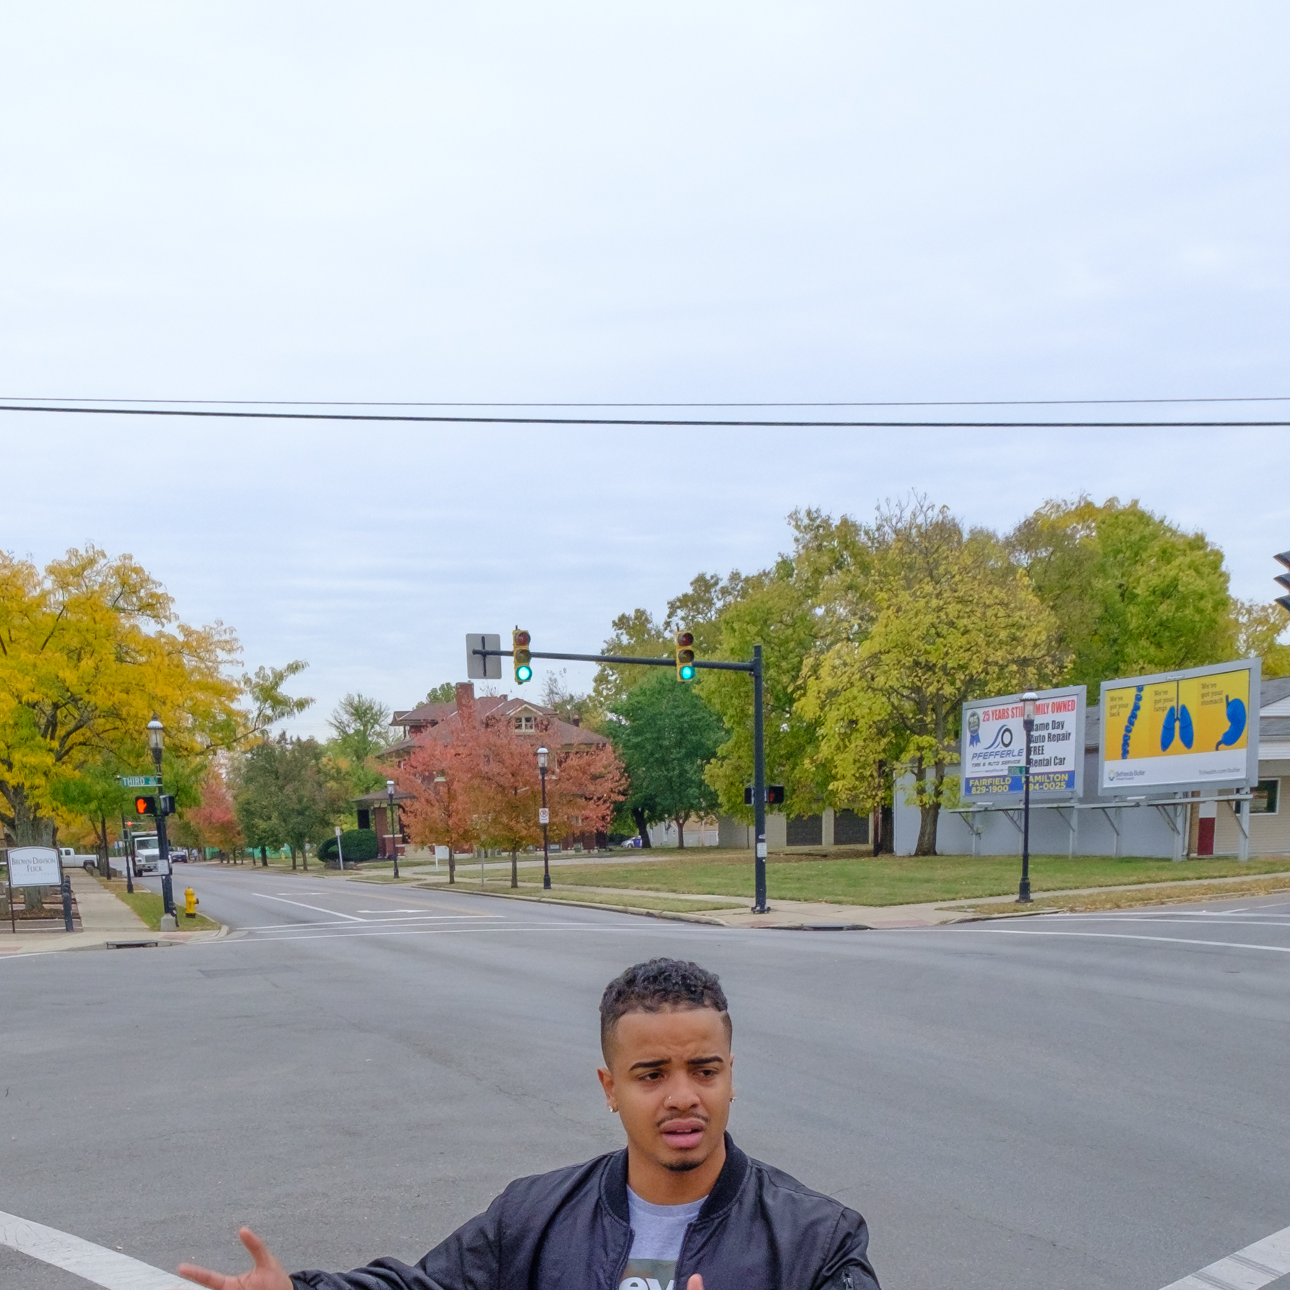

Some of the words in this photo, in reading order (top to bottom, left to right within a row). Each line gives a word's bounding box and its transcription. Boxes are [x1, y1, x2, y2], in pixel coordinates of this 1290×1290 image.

[982, 709, 990, 722] 25
[991, 707, 1010, 720] YEARS
[1051, 699, 1076, 714] OWNED
[1033, 722, 1050, 731] ame
[1051, 719, 1065, 730] Day
[1047, 731, 1071, 743] Repair
[971, 748, 1024, 760] PFEFFERLE
[1029, 745, 1045, 756] FREE
[1029, 757, 1052, 768] Rental
[1053, 756, 1066, 766] Car
[122, 777, 146, 786] THIRD
[969, 777, 1012, 786] FAIRFIELD
[971, 785, 1009, 794] 829-1900
